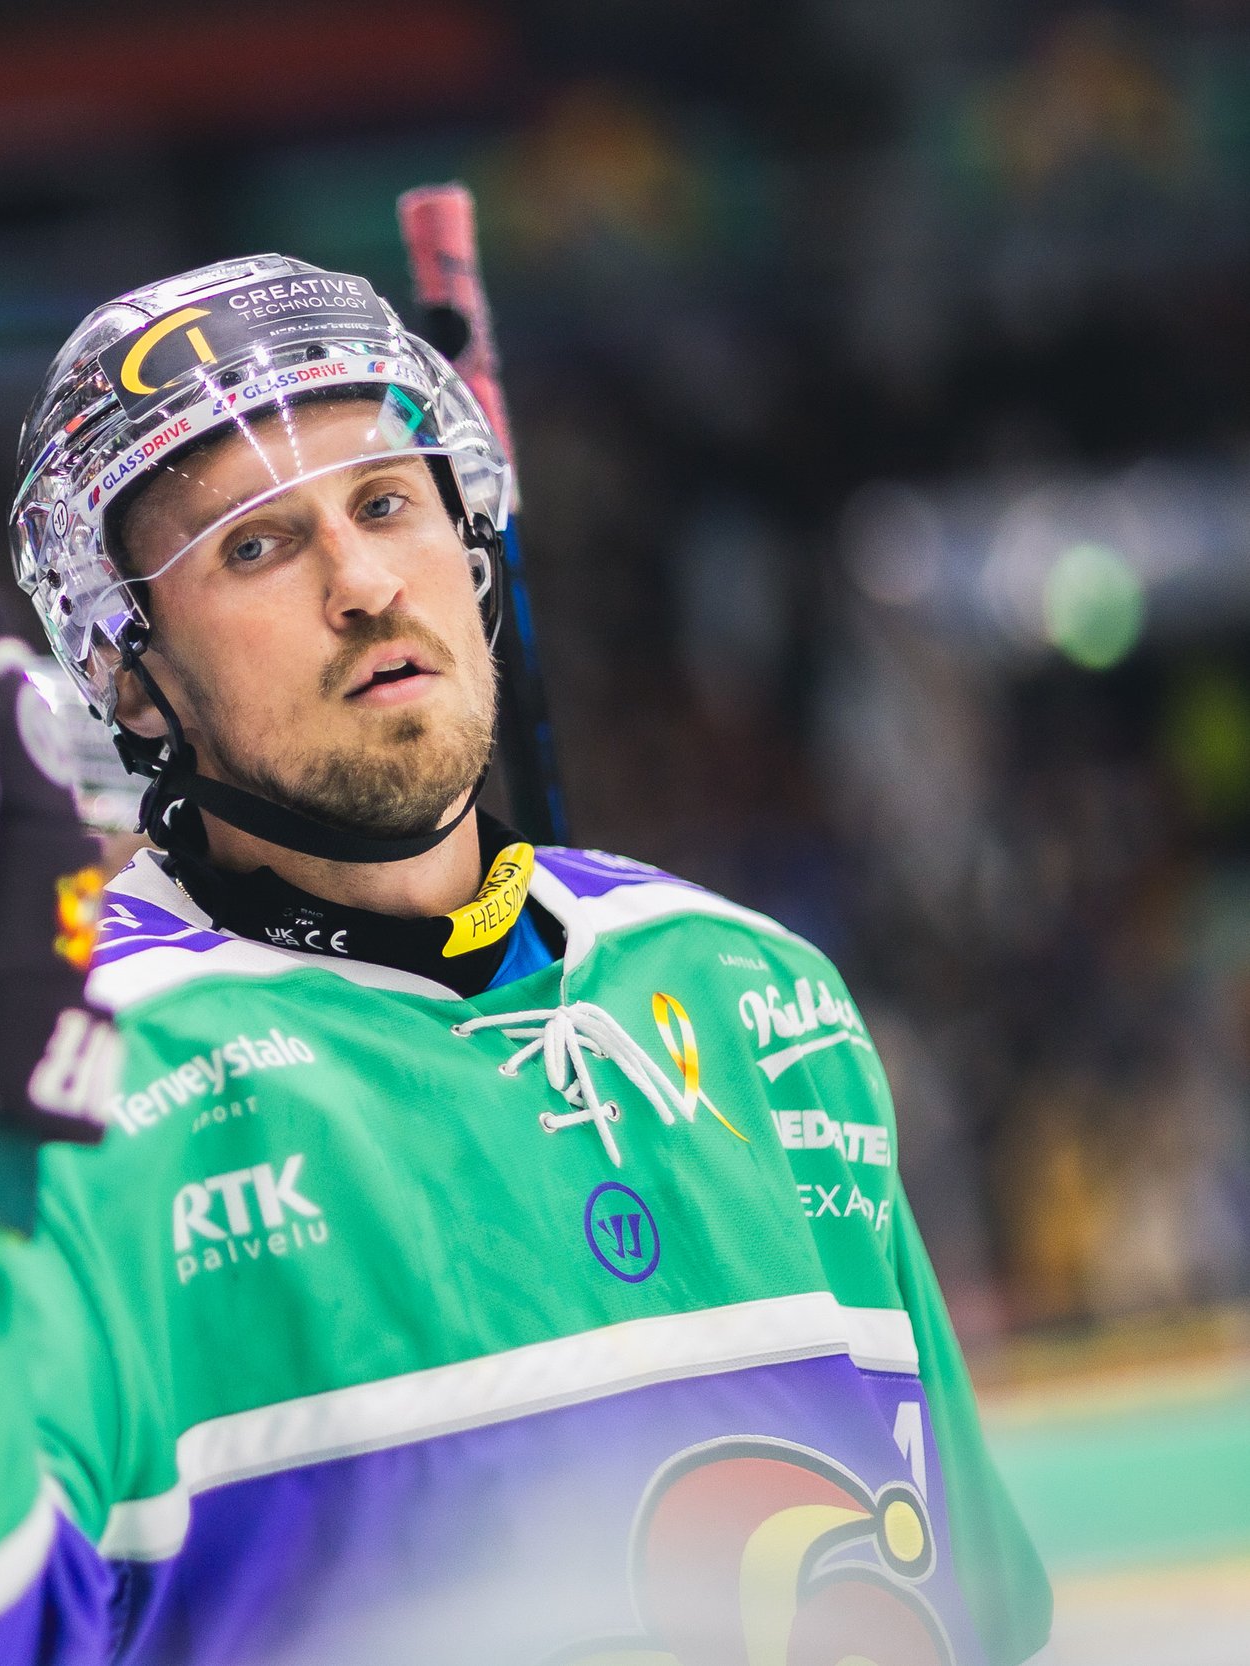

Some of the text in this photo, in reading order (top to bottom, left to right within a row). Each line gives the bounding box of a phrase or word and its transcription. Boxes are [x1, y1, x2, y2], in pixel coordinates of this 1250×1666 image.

[228, 279, 362, 310] CREATIVE
[238, 296, 367, 321] TECHNOLOGY
[242, 362, 348, 399] GLASSDRIVE
[102, 417, 192, 490] GLASSDRIVE
[172, 1153, 322, 1253] RTK
[176, 1221, 329, 1285] palvelu
